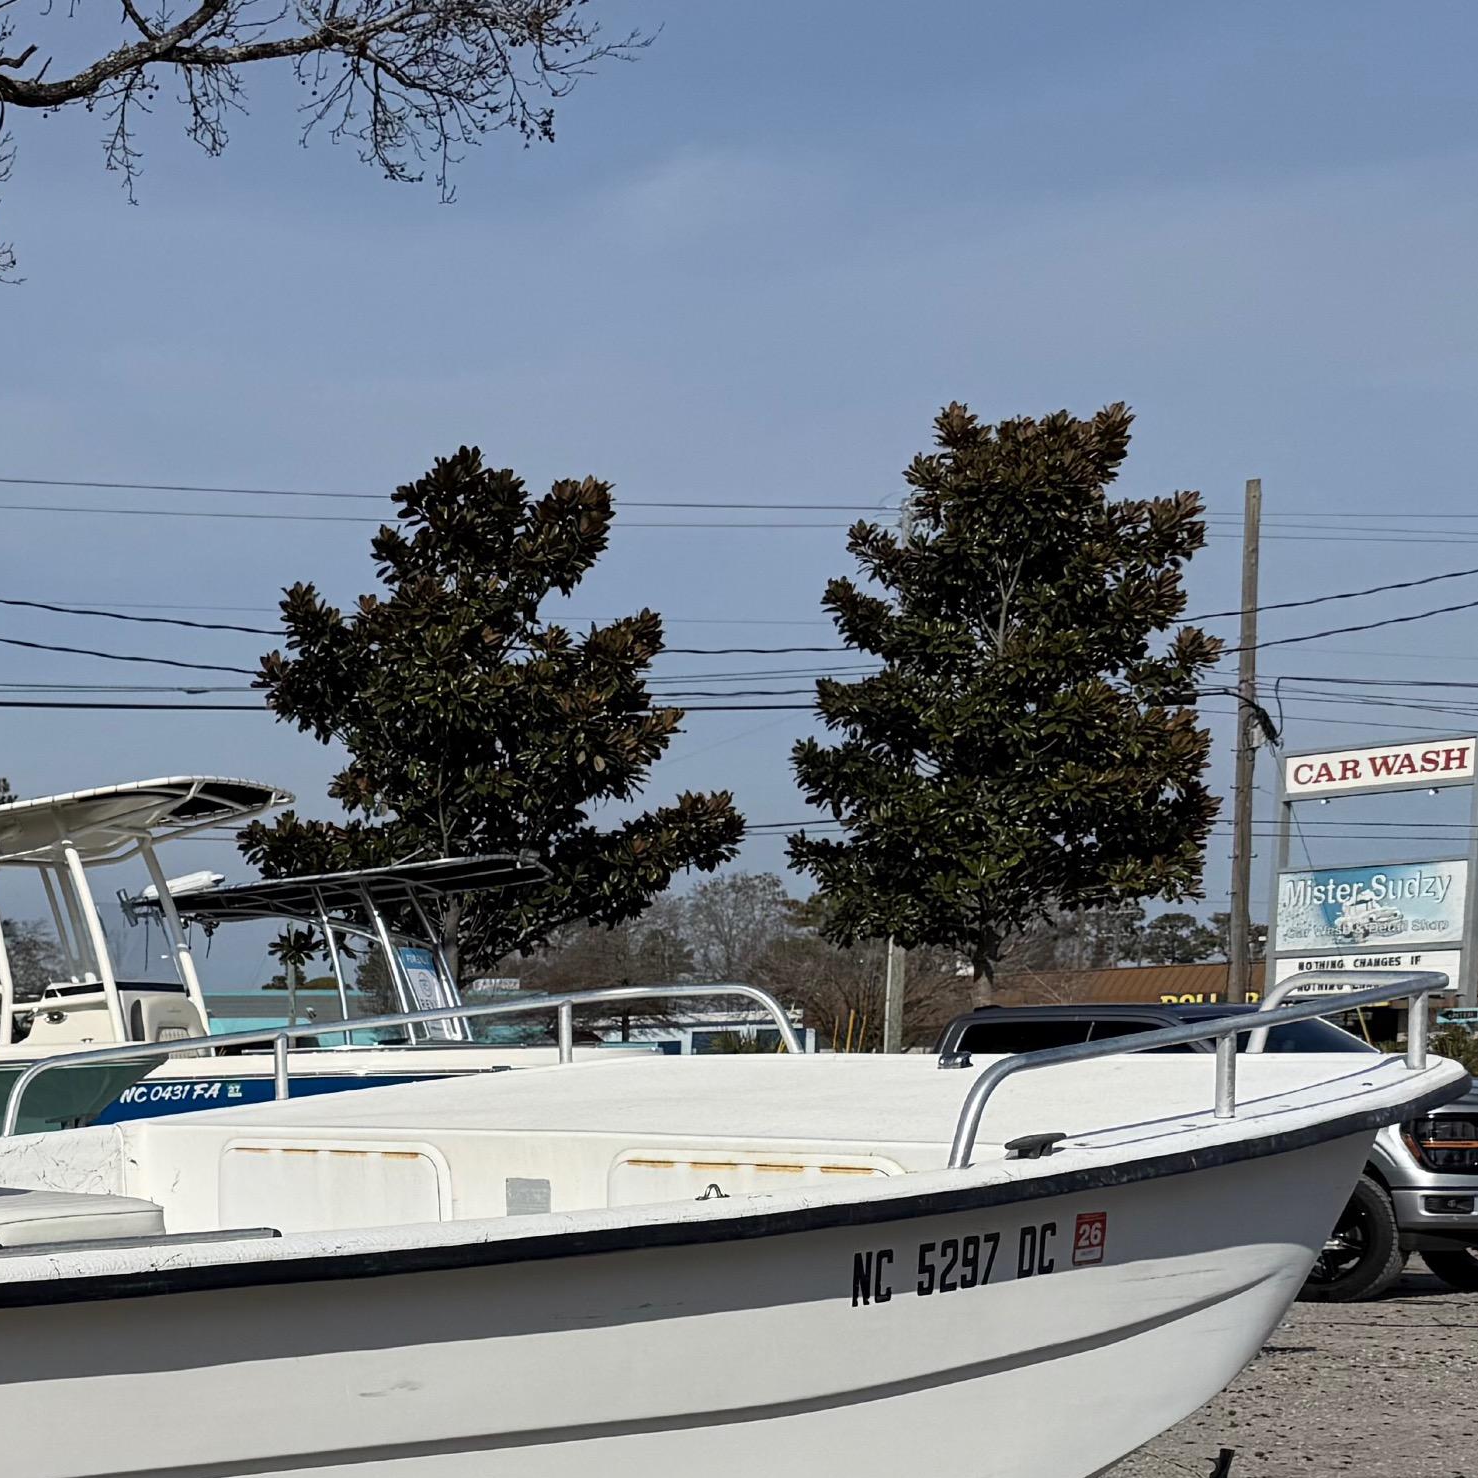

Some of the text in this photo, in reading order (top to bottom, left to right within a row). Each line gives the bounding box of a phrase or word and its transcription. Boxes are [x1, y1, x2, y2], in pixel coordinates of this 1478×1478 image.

[1293, 747, 1470, 785] CAR WASH
[1285, 871, 1452, 906] Mister Sudzy
[1298, 955, 1422, 971] NOTHING CHANGES IF
[119, 1082, 222, 1104] NC 0431 FA
[1078, 1222, 1102, 1247] 26
[852, 1222, 1057, 1307] NC 5297 DC
